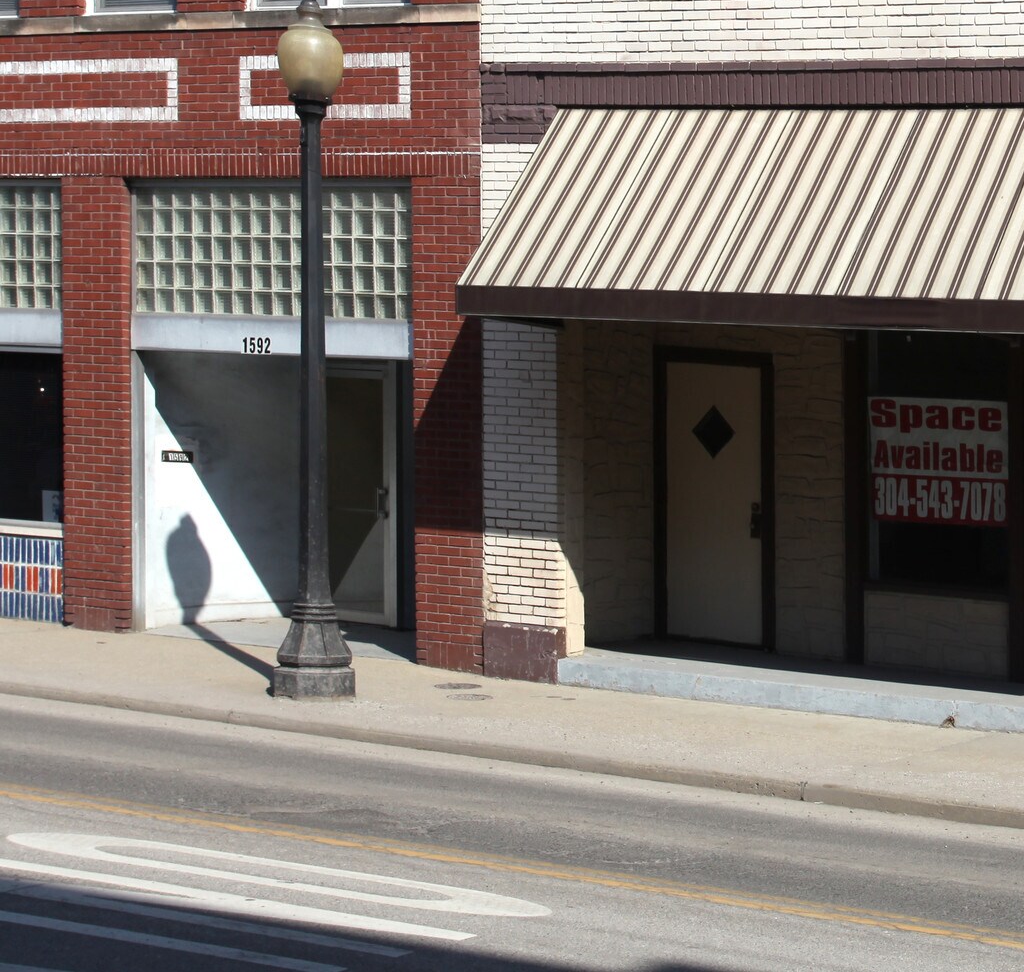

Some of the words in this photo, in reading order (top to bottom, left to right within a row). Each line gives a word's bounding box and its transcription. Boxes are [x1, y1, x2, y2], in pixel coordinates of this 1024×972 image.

[242, 337, 272, 354] 1592
[870, 399, 1002, 433] Space
[874, 440, 1003, 473] Available
[874, 477, 1007, 522] 304-543-7078
